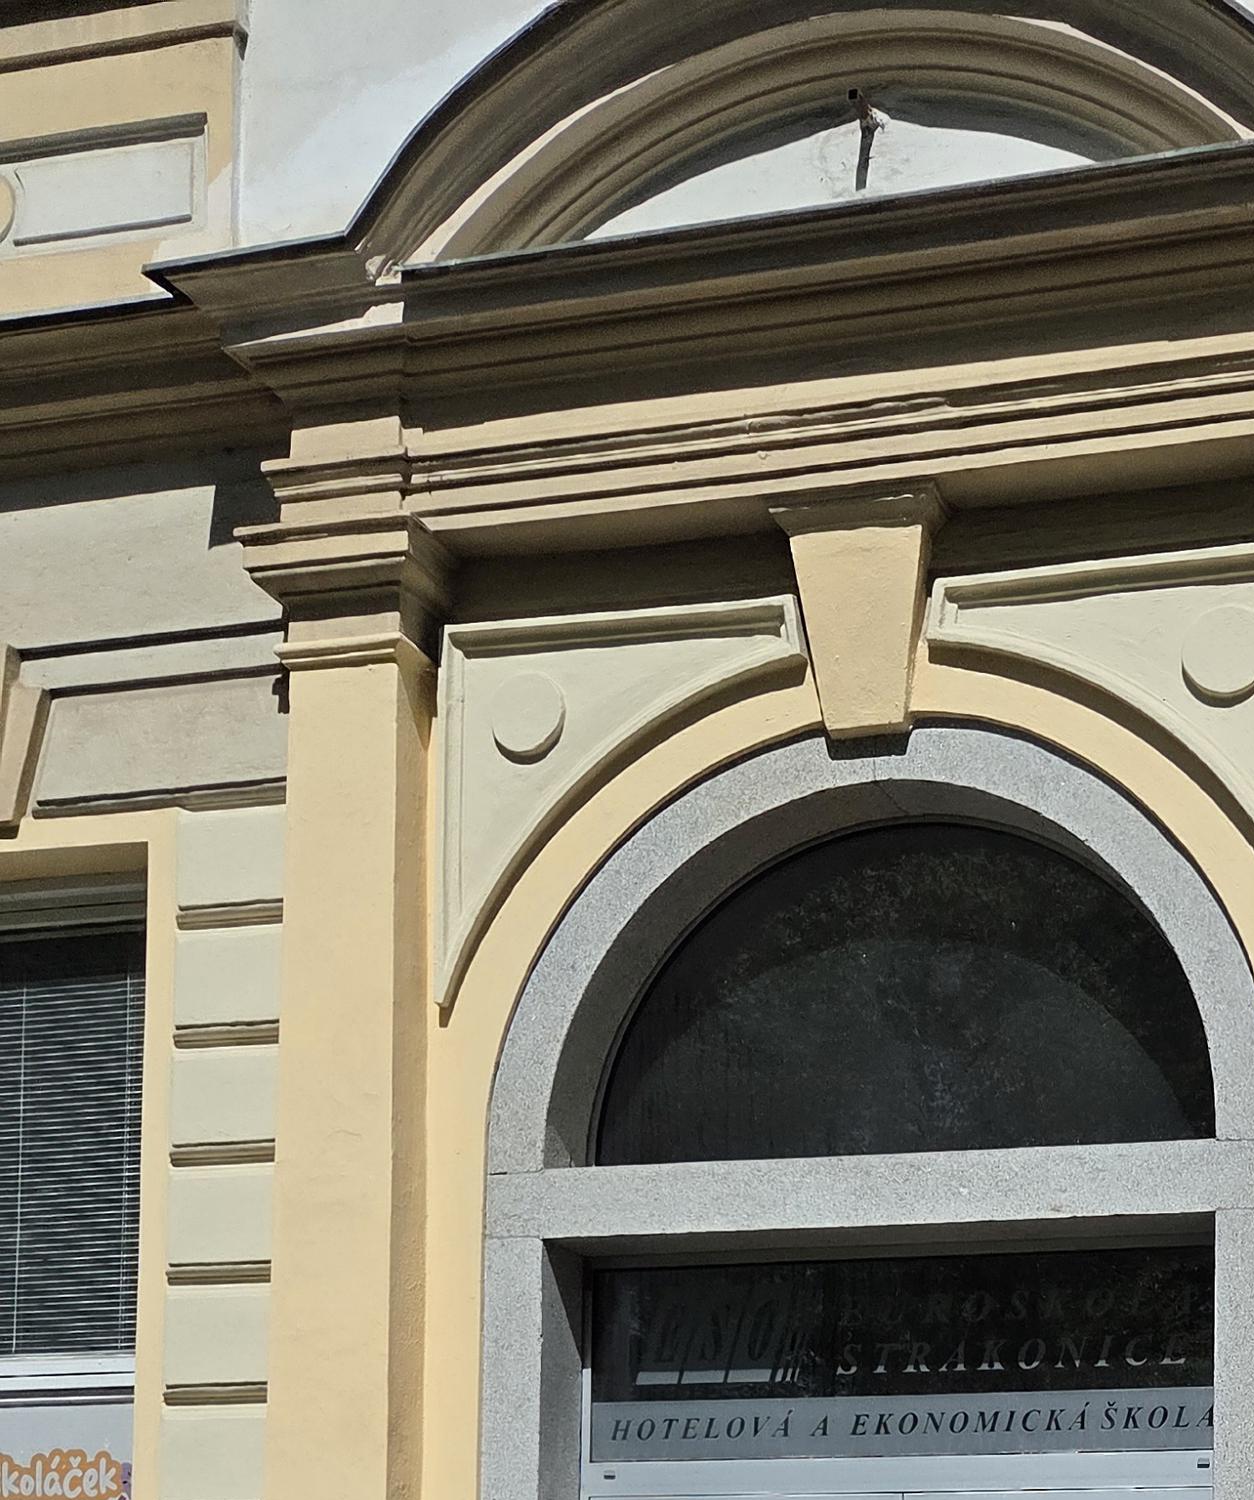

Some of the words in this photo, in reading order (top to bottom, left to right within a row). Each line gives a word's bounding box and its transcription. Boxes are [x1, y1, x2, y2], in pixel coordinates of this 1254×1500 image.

[836, 1333, 1190, 1376] STRAKONICE
[611, 1409, 793, 1440] HOTELOVÁ
[809, 1405, 829, 1437] A
[850, 1402, 1090, 1435] EKONOMICKÁ
[1101, 1401, 1214, 1430] ŠKOLA
[2, 1455, 118, 1499] koláček
